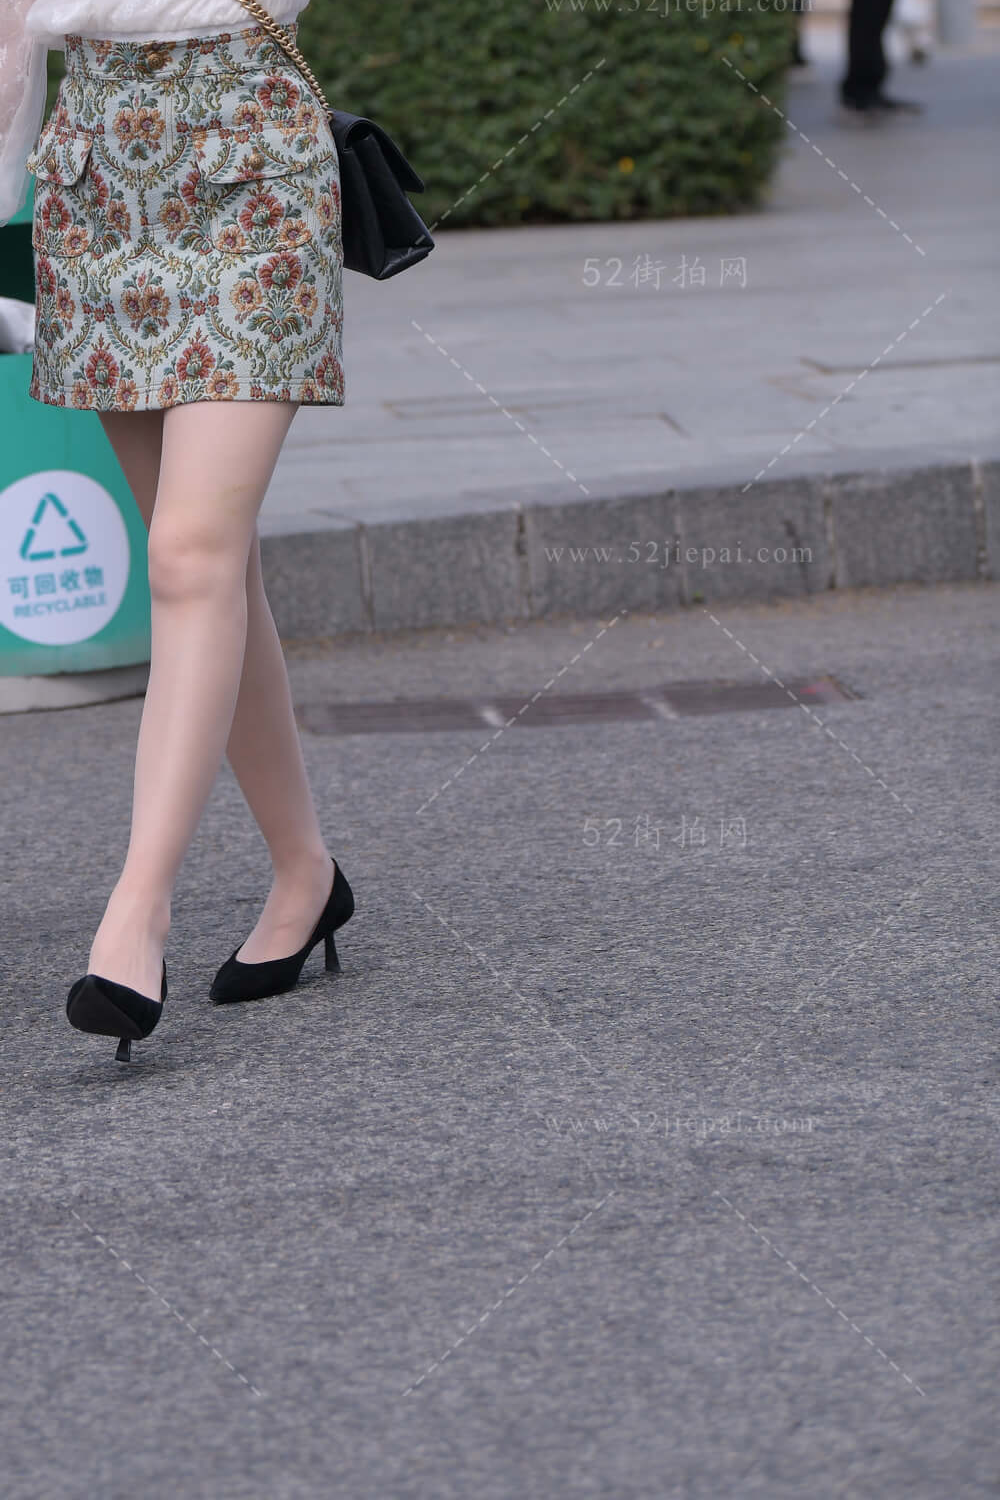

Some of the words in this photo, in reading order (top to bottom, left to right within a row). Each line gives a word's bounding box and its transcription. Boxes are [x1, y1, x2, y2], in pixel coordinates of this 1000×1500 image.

[8, 565, 104, 599] 可回收物
[13, 592, 106, 618] RECYCLABLE
